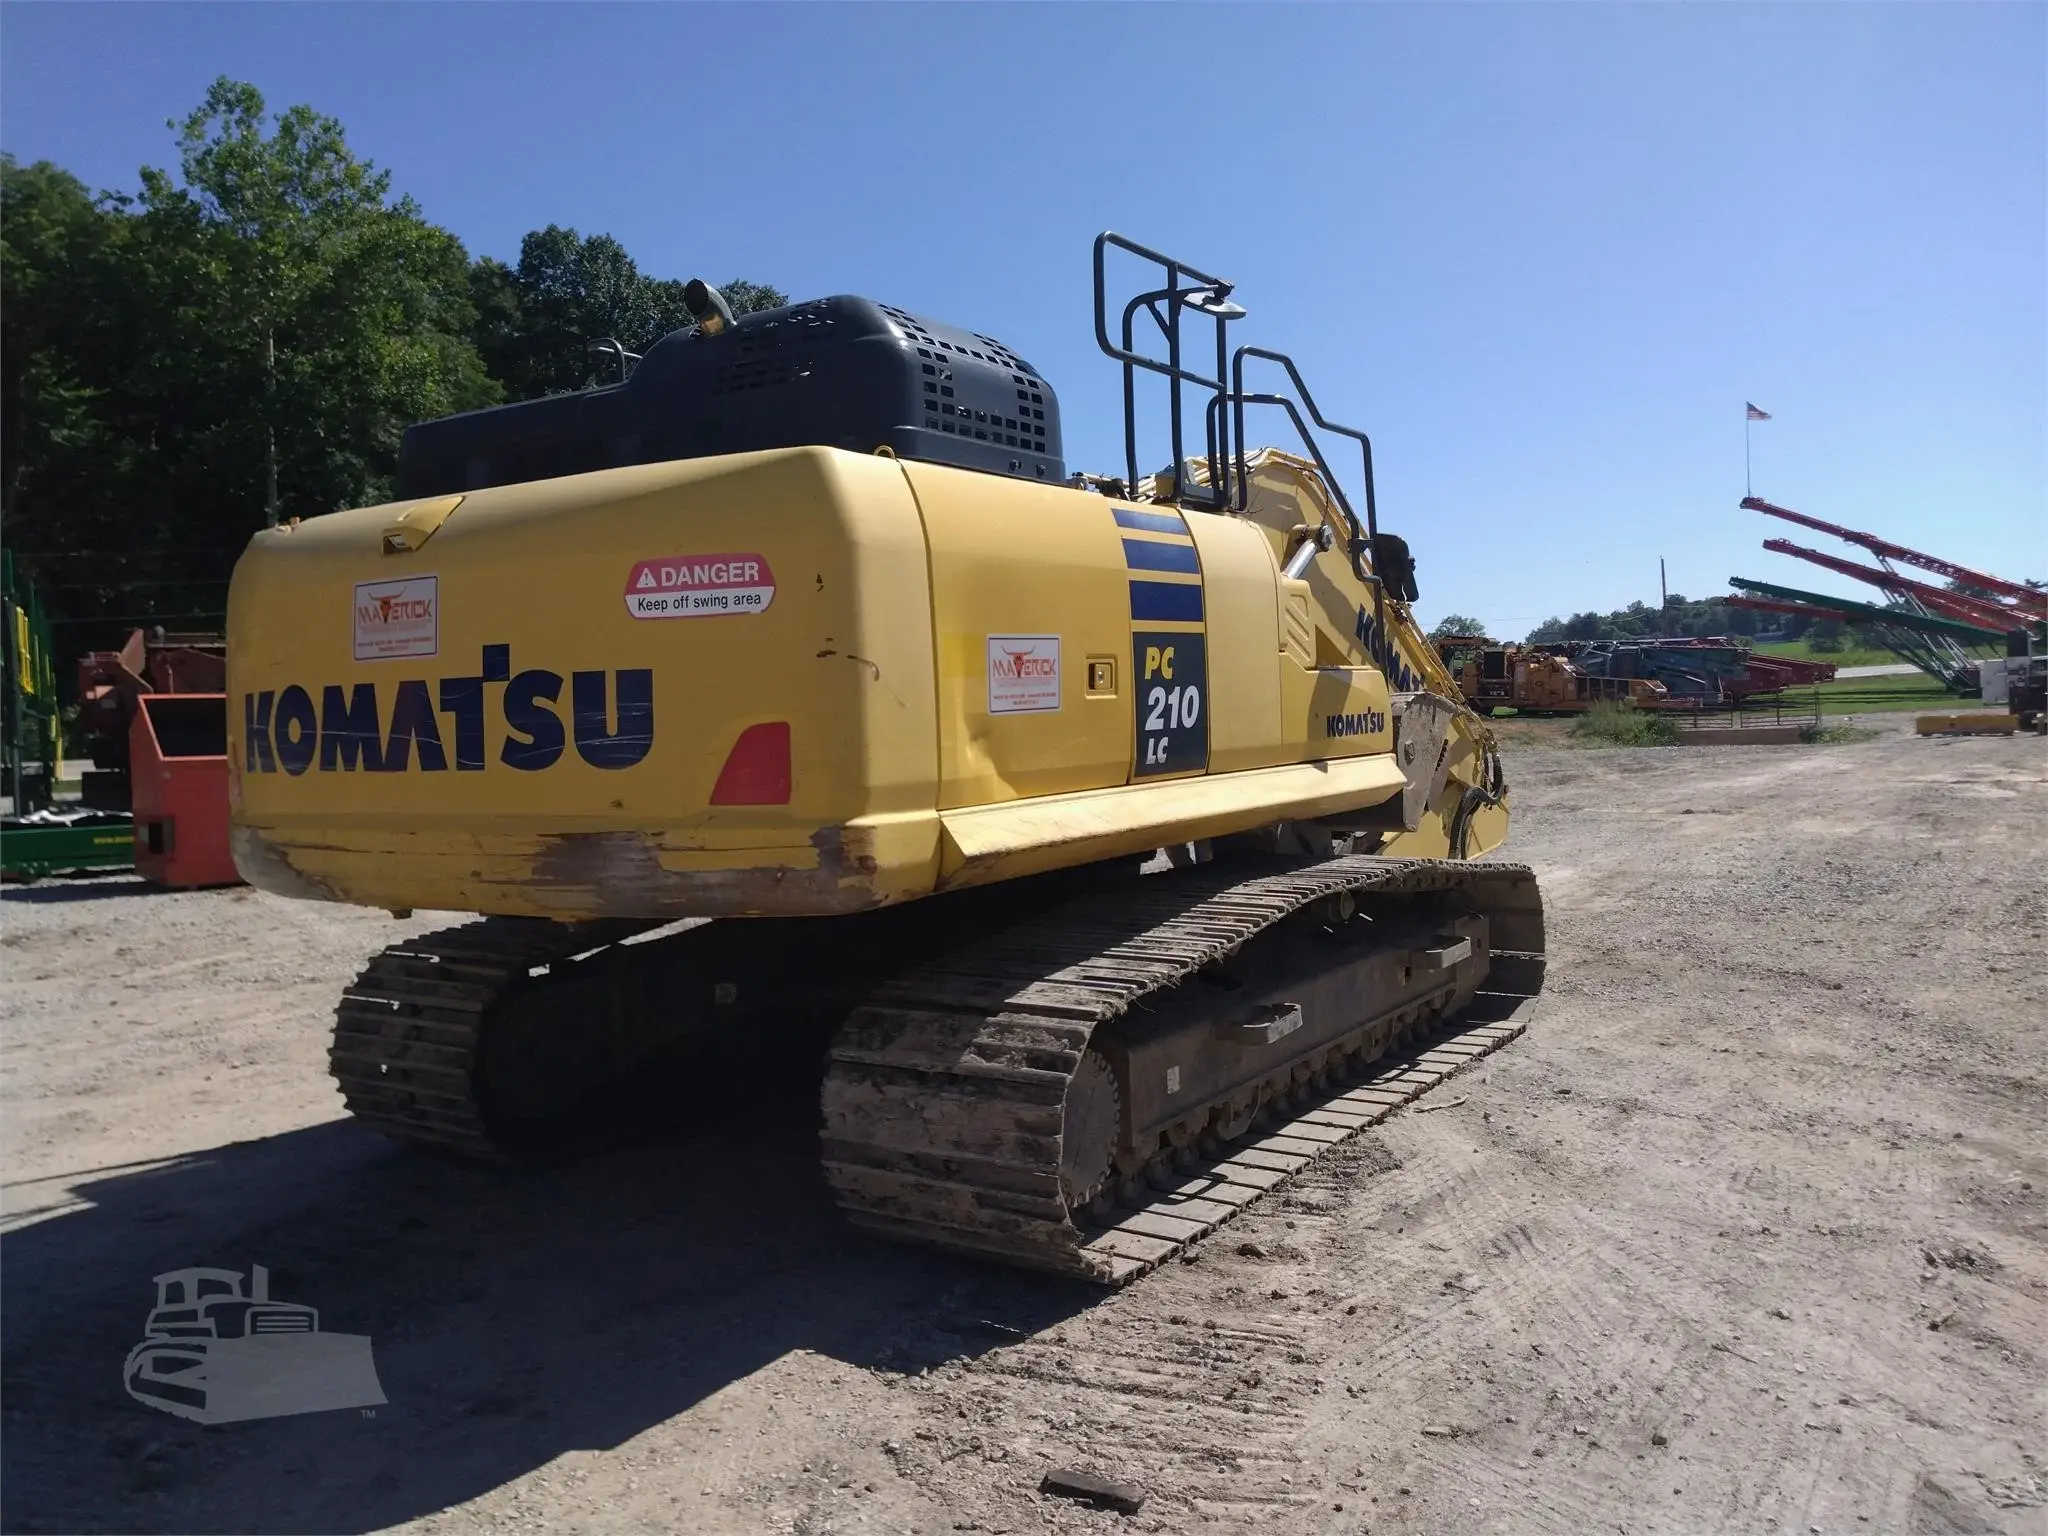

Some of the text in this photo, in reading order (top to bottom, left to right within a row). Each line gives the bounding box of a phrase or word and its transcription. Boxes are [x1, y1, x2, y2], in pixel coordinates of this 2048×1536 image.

[661, 561, 759, 587] DANGER
[638, 593, 761, 613] Keep off swing area
[1144, 646, 1175, 680] PC
[245, 643, 654, 776] KOMATSU
[1144, 685, 1200, 731] 210
[1326, 706, 1385, 738] KOMATSU
[1146, 736, 1169, 765] LC
